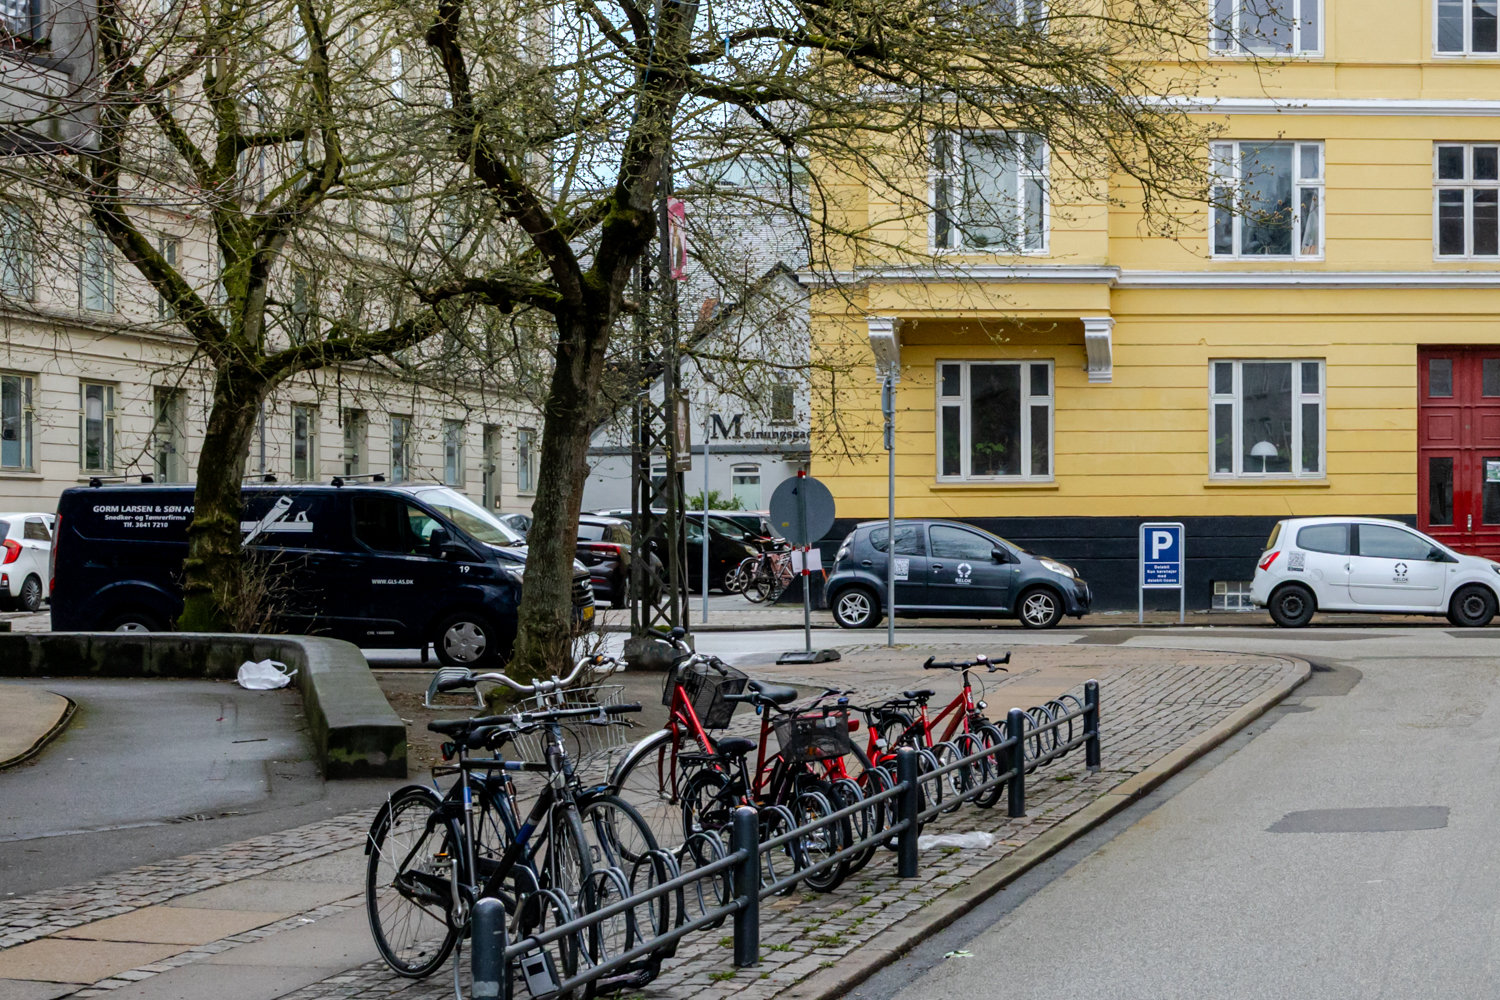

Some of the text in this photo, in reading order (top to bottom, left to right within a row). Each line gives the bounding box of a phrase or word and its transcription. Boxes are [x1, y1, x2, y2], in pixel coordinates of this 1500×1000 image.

[93, 505, 119, 513] GORM
[121, 505, 153, 513] LARSEN
[154, 505, 162, 513] &
[163, 505, 182, 513] SØN
[1152, 530, 1173, 559] P
[459, 565, 470, 573] 19
